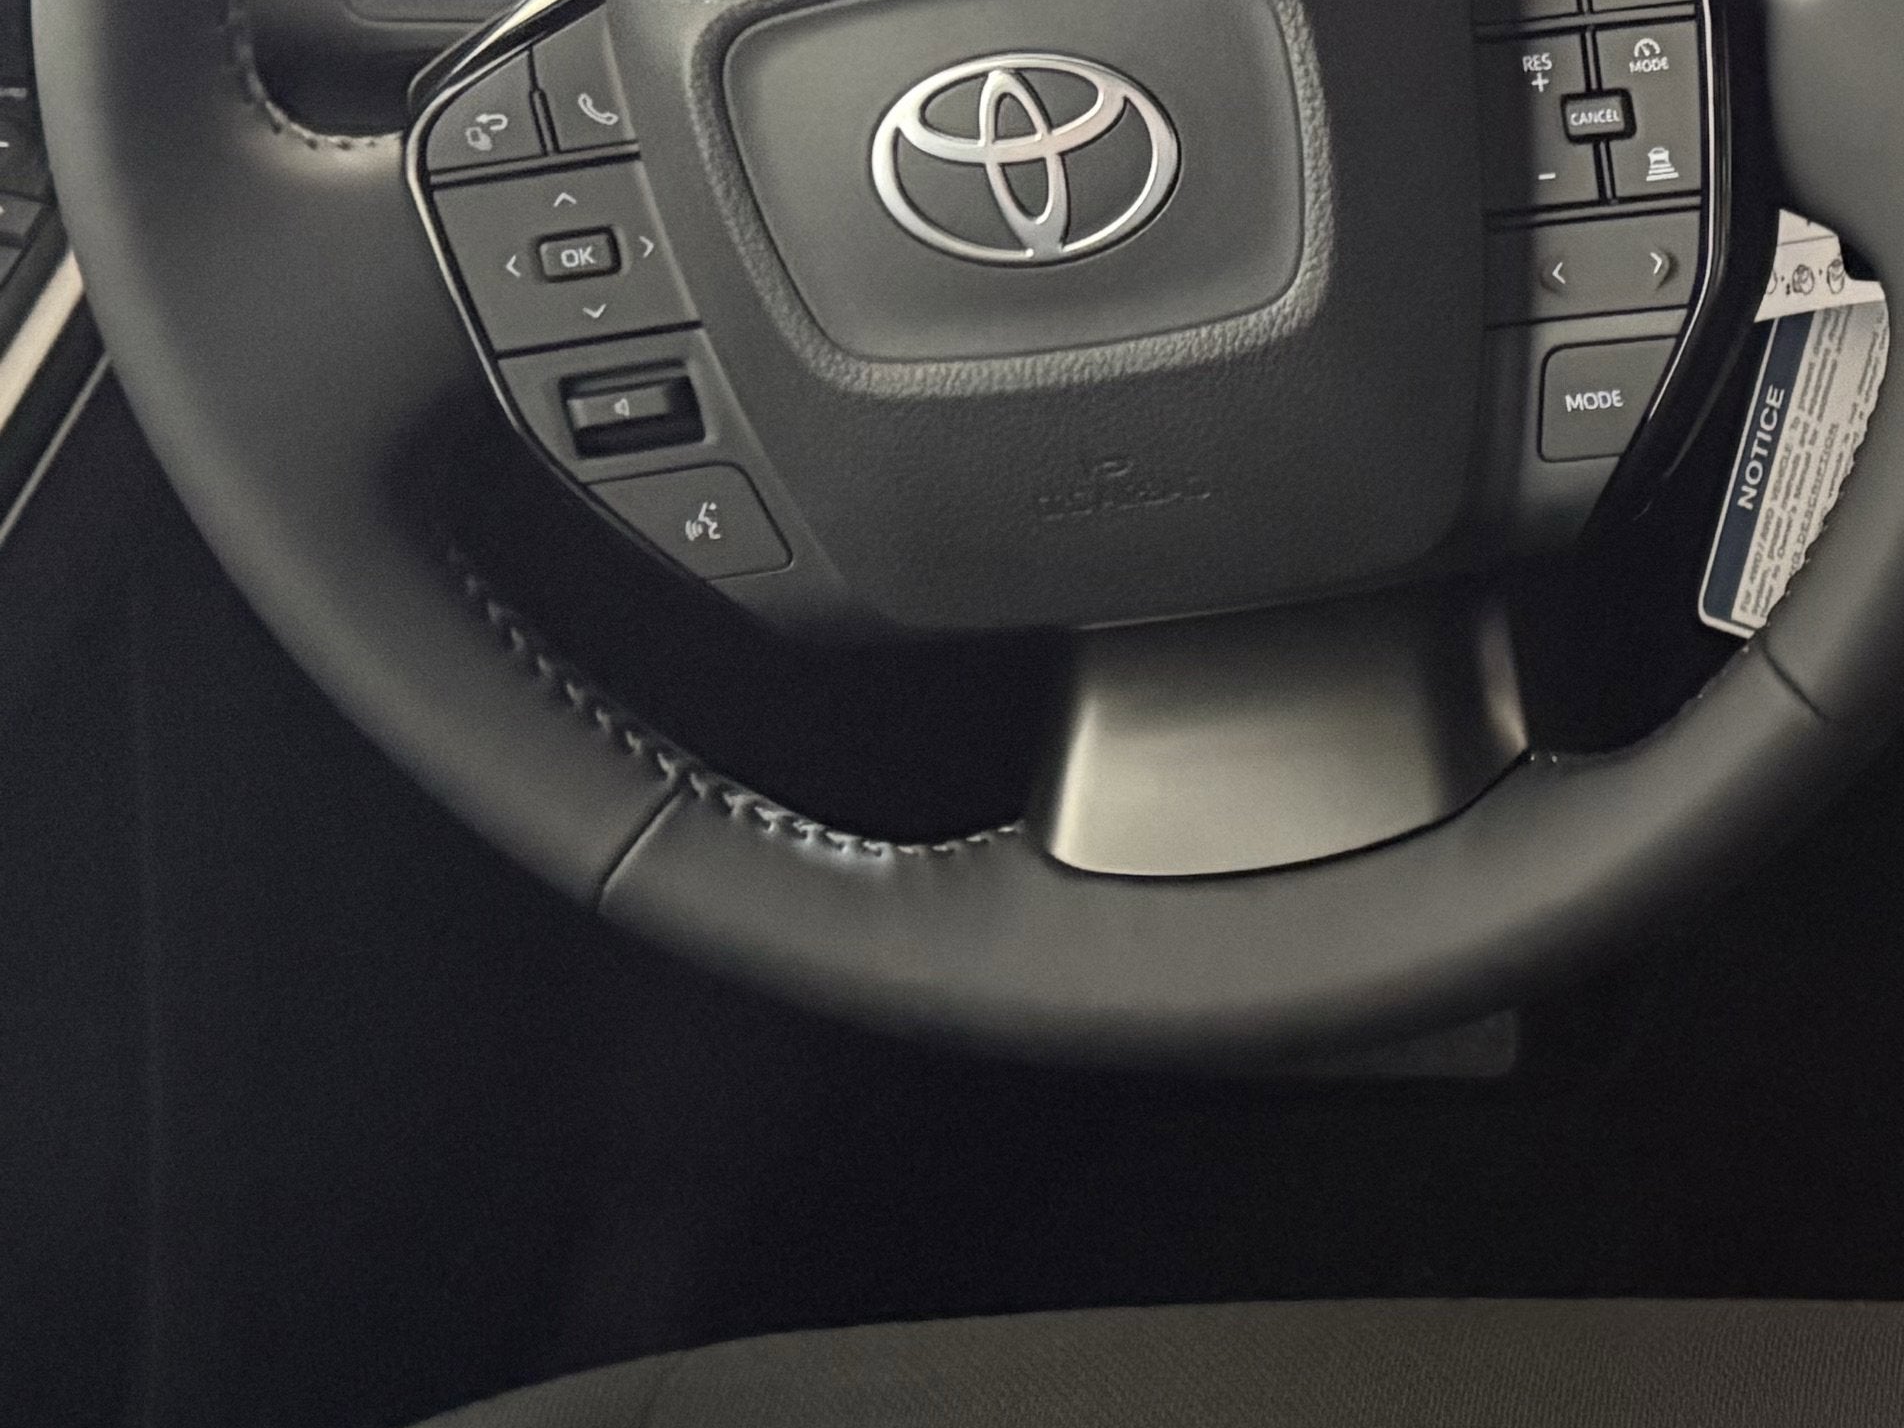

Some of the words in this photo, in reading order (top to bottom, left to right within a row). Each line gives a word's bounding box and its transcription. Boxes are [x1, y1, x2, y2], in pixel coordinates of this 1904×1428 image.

[1523, 53, 1552, 72] RES
[1629, 56, 1670, 73] MODE
[1570, 109, 1620, 126] CANCEL
[560, 245, 596, 269] OK
[1564, 390, 1624, 412] MODE
[1738, 384, 1785, 510] NOTICE
